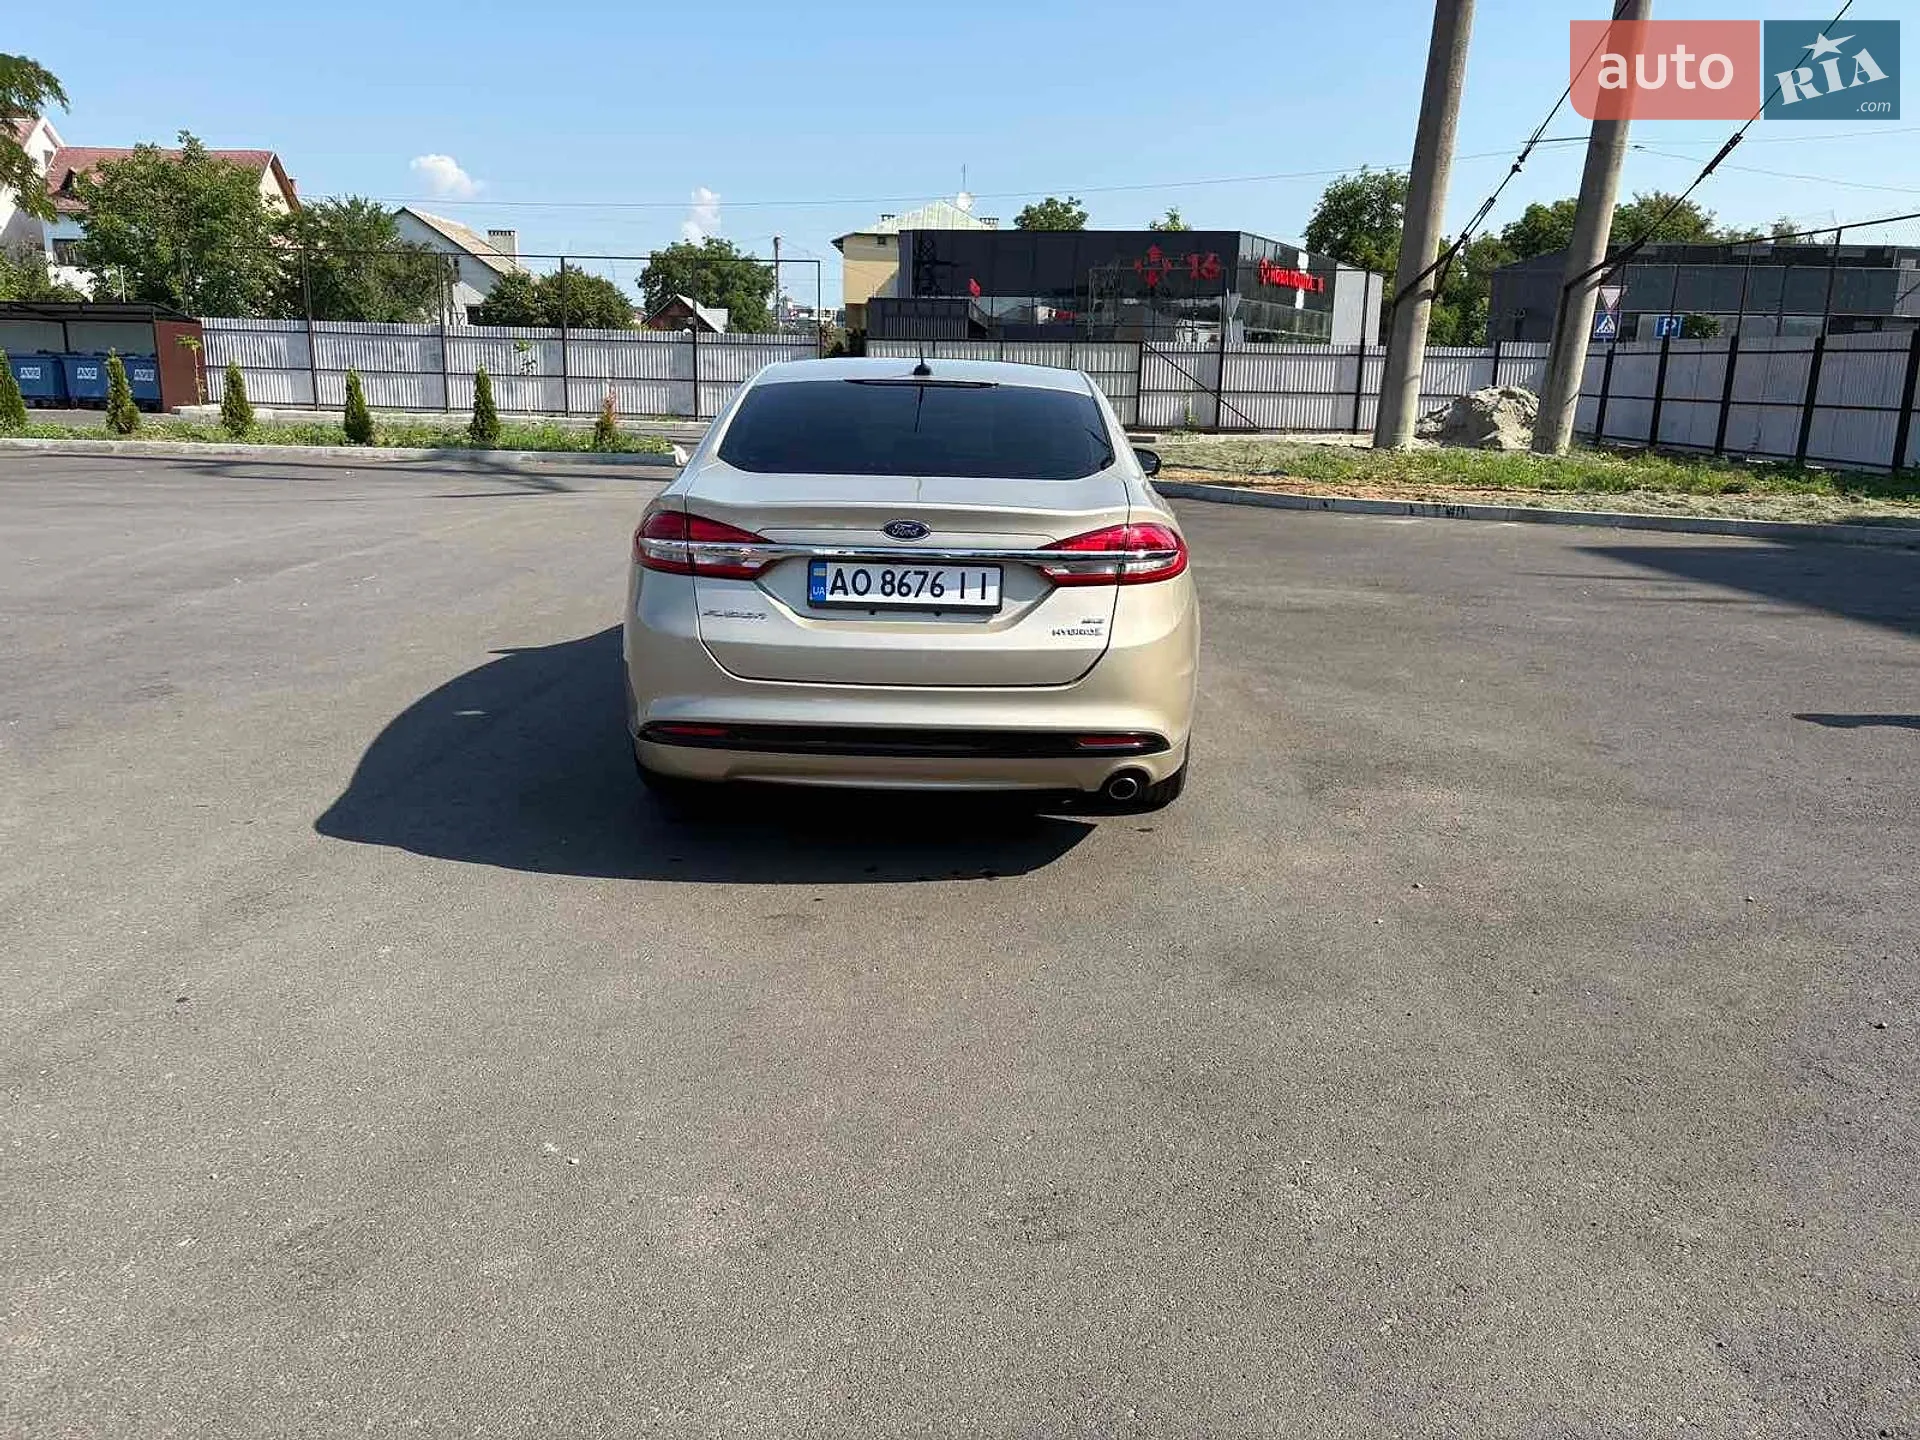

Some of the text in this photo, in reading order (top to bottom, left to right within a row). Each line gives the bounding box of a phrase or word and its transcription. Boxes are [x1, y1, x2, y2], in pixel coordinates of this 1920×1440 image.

[812, 586, 827, 596] UA
[829, 567, 987, 600] AO 8676 II
